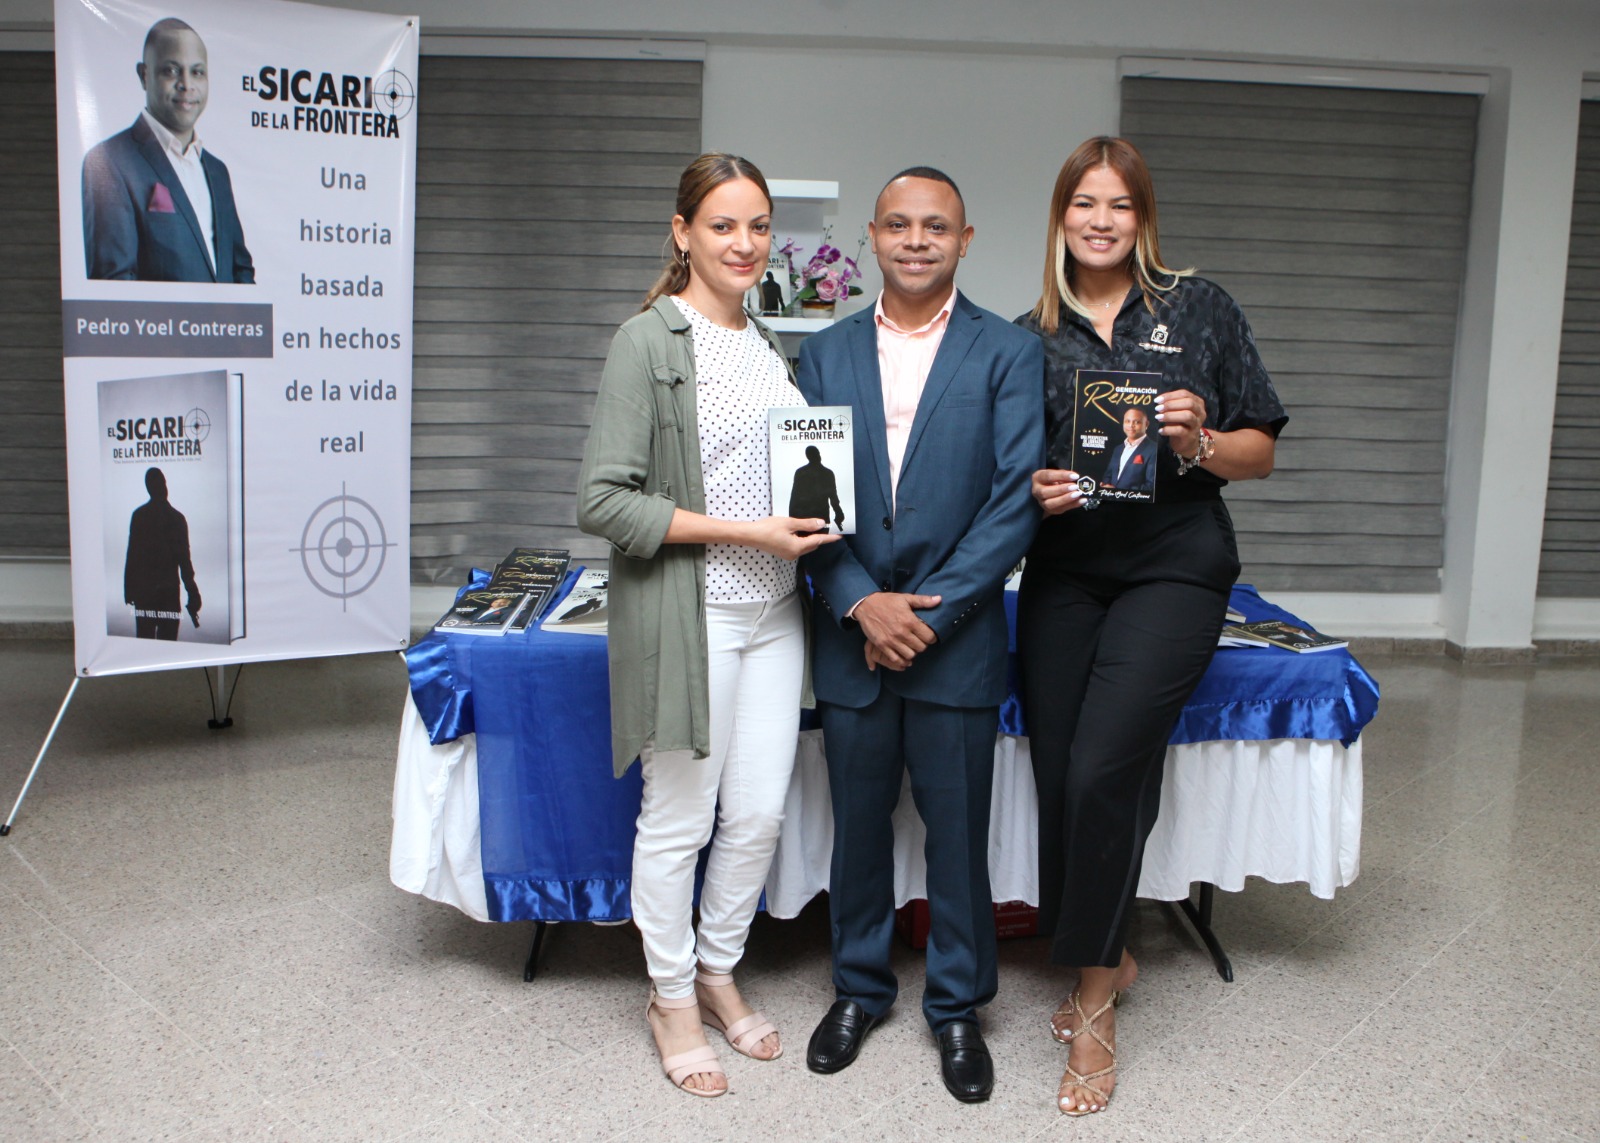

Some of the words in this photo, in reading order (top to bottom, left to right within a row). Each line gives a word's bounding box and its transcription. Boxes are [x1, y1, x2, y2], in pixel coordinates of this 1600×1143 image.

[242, 75, 257, 92] EL
[252, 111, 268, 128] DE
[272, 113, 289, 130] LA
[294, 106, 400, 138] FRONTERA
[321, 167, 366, 190] Una
[300, 219, 391, 245] historia
[301, 273, 383, 297] basada
[77, 318, 130, 335] Pedro
[135, 319, 173, 336] Yoel
[179, 320, 264, 337] Contreras
[282, 332, 310, 349] en
[320, 327, 401, 349] hechos
[285, 379, 313, 402] de
[322, 379, 341, 401] la
[349, 379, 397, 401] vida
[1084, 379, 1152, 424] Relevo
[1115, 386, 1158, 395] GENERACIÓN
[107, 427, 116, 437] EL
[320, 431, 363, 453] real
[799, 431, 845, 440] FRONTERA
[113, 448, 123, 458] DE
[124, 448, 134, 458] LA
[136, 439, 202, 458] FRONTERA
